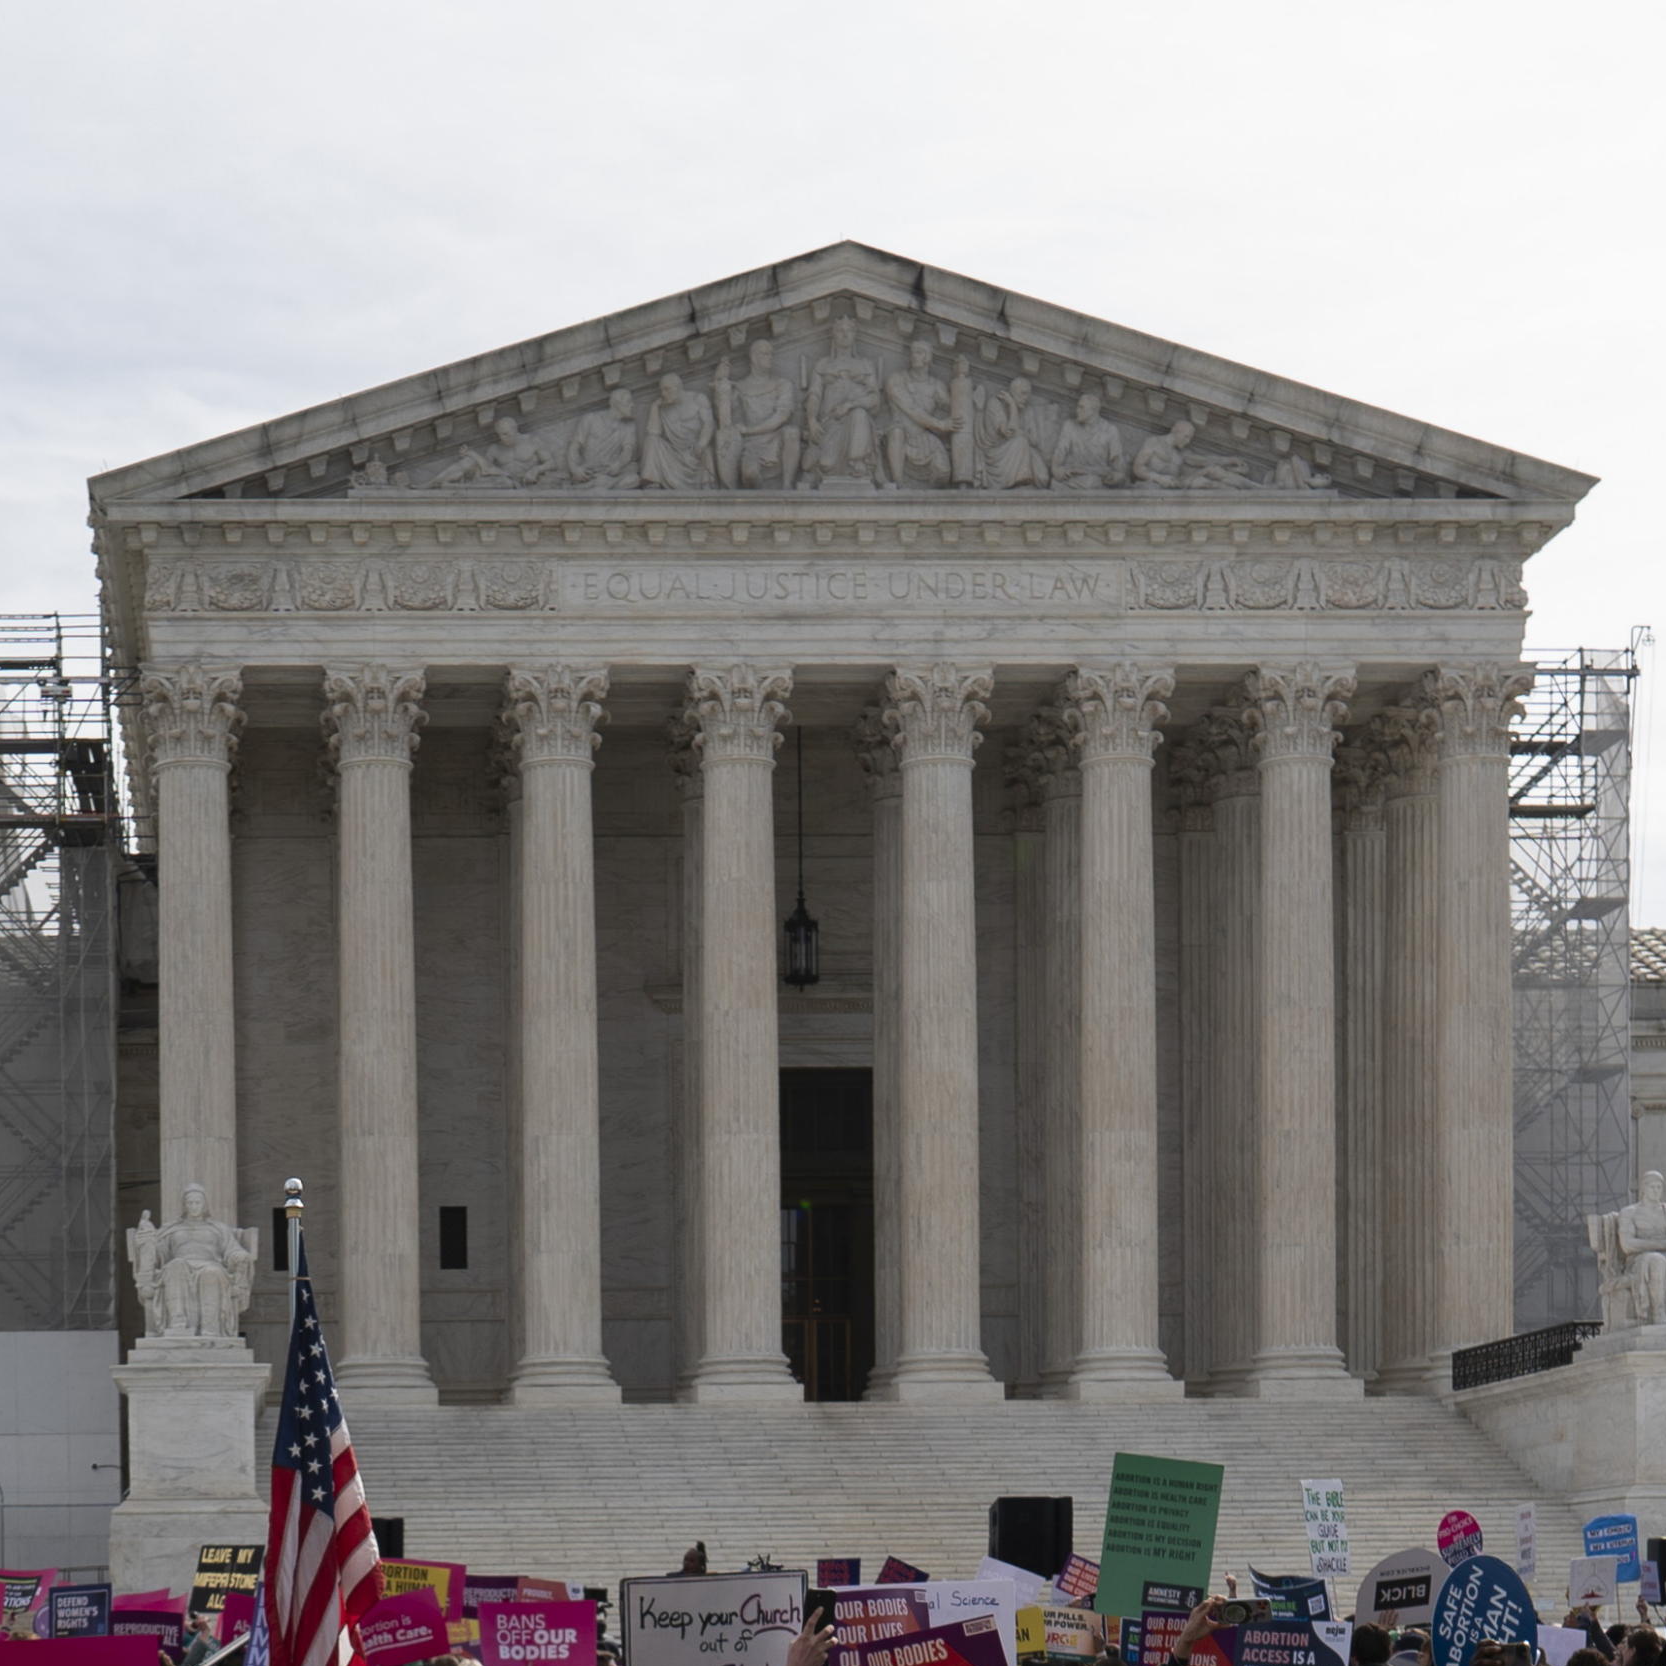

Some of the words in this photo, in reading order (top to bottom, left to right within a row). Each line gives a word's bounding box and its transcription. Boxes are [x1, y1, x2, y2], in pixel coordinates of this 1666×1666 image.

[583, 572, 710, 602] EQUAL
[719, 572, 868, 601] JUSTICE
[887, 572, 1008, 600] UNDER
[1029, 572, 1101, 600] LAW
[1305, 1488, 1320, 1507] THE
[1159, 1506, 1189, 1517] PRIVACY
[1157, 1520, 1190, 1532] EQUALITY
[1168, 1535, 1202, 1547] DECISION
[1311, 1541, 1324, 1553] BUT
[1328, 1540, 1340, 1552] NOT
[201, 1548, 233, 1563] LEAVE
[237, 1548, 256, 1563] MY
[1317, 1558, 1347, 1573] SHACKLE
[951, 1591, 1000, 1607] Science
[1148, 1587, 1181, 1598] AMNESTY
[1381, 1584, 1426, 1601] BLICK
[58, 1596, 89, 1607] DEFEND
[835, 1601, 864, 1620] OUR
[867, 1598, 909, 1617] BODIES
[58, 1606, 98, 1618] WOMEN'S
[639, 1596, 693, 1640] Keep
[699, 1611, 739, 1636] your
[740, 1594, 801, 1625] Church
[1439, 1583, 1462, 1639] SAFE
[58, 1617, 88, 1629] RIGHTS
[497, 1614, 546, 1629] BANS
[497, 1630, 533, 1645] OFF
[534, 1629, 577, 1644] OUR
[700, 1632, 727, 1652] out
[734, 1629, 753, 1652] of
[837, 1625, 868, 1645] OUR
[1244, 1630, 1309, 1647] ABORTION
[499, 1645, 569, 1660] BODIES
[1242, 1648, 1290, 1664] ACCESS
[1292, 1652, 1304, 1664] IS
[1306, 1652, 1315, 1665] A
